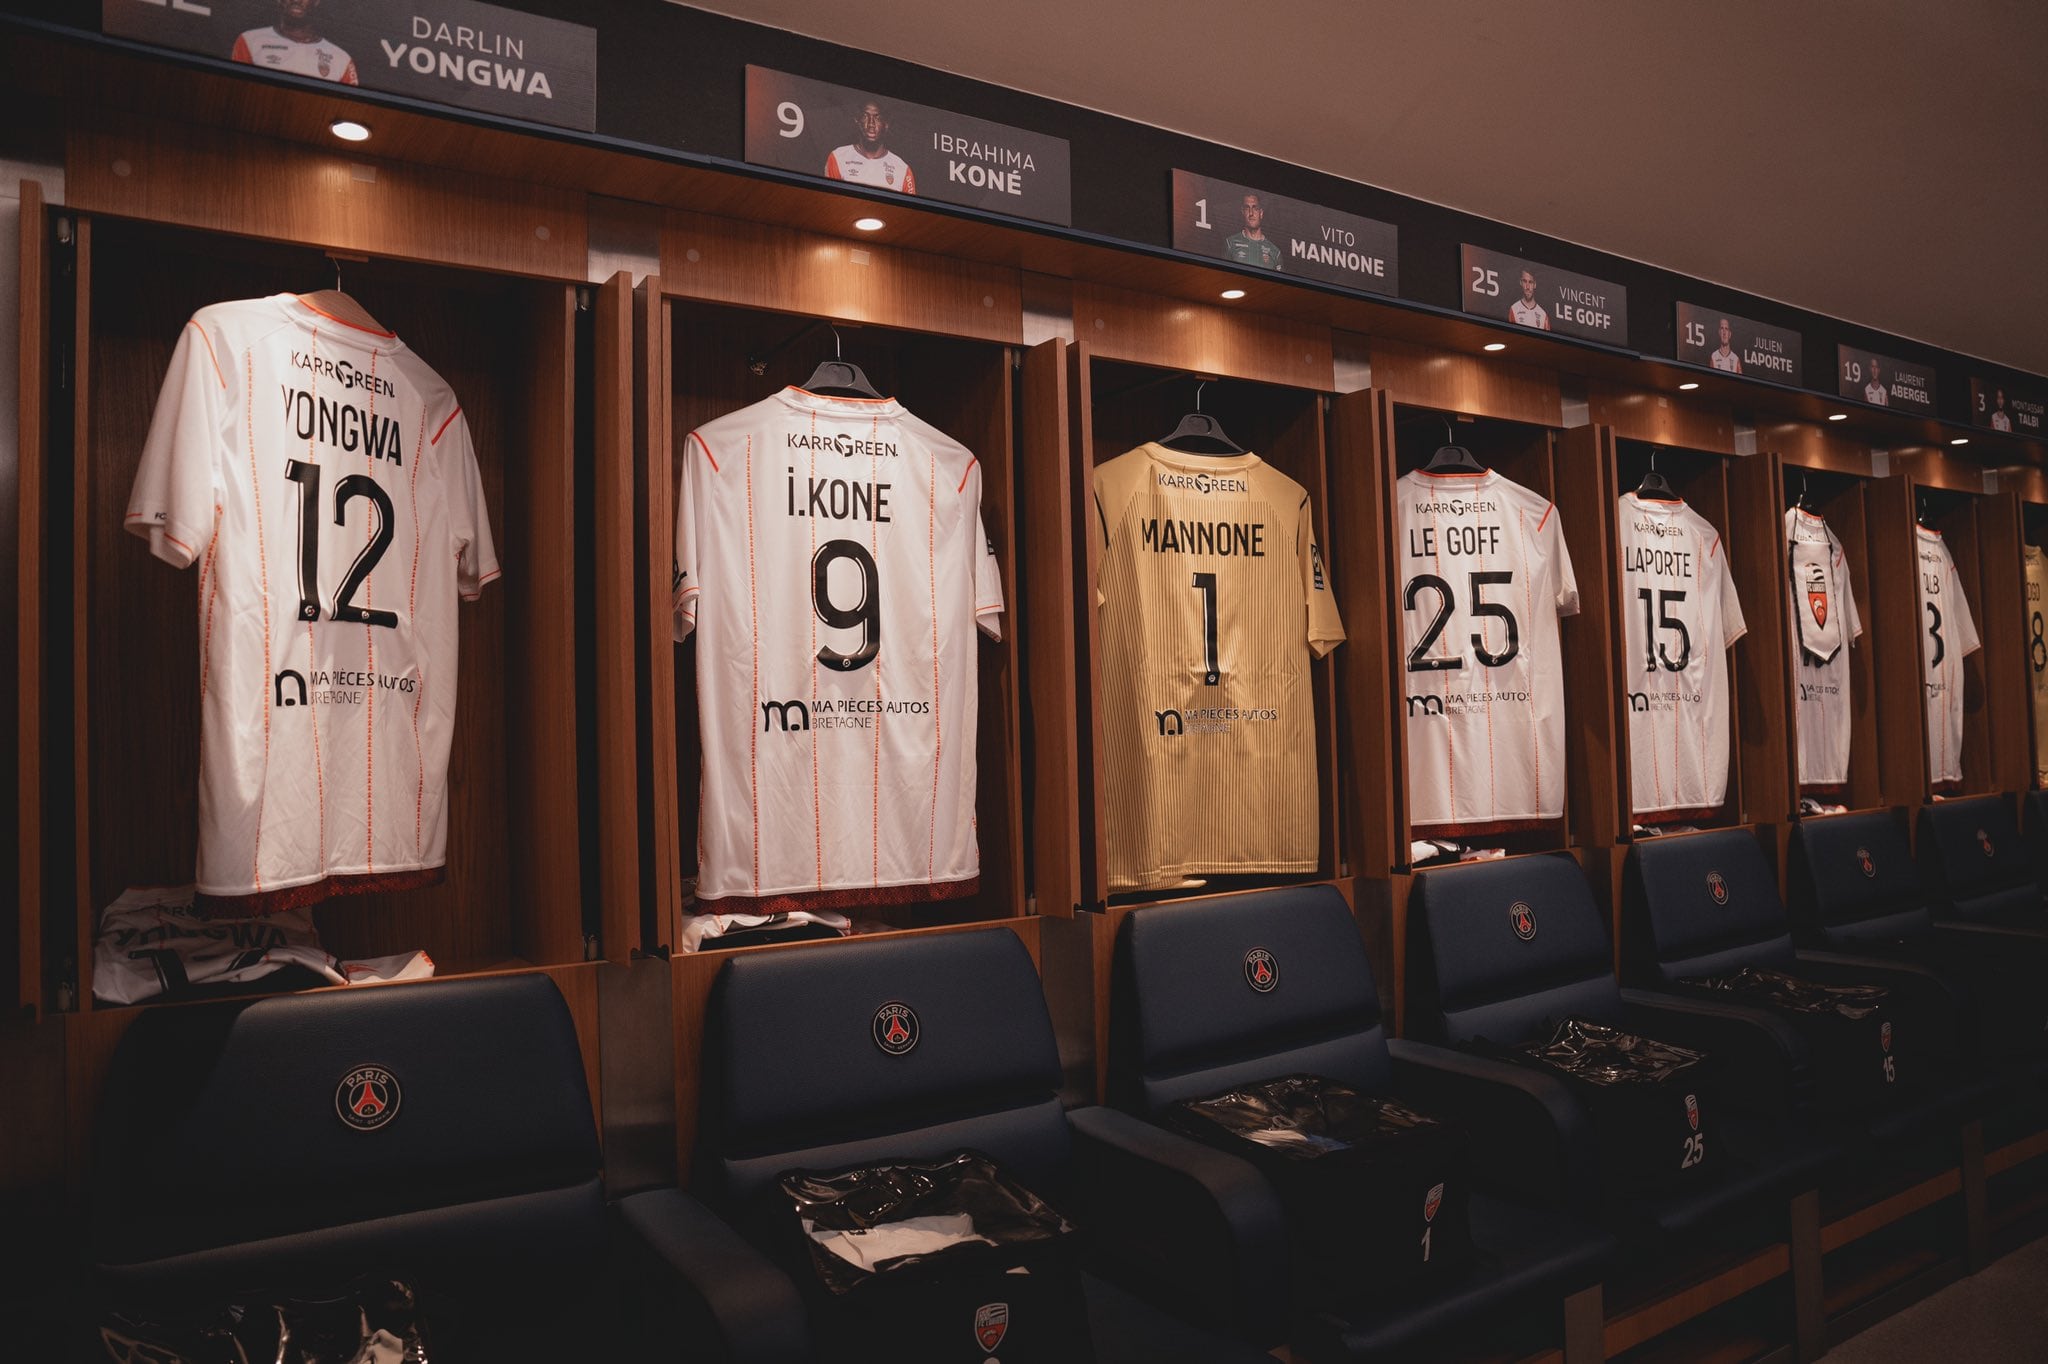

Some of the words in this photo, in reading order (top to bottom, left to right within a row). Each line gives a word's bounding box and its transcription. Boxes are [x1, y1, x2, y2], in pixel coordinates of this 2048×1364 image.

[411, 15, 525, 61] DARLIN
[380, 38, 553, 99] YONGWA
[776, 101, 805, 138] 9
[933, 132, 1036, 172] IBRAHIMA
[949, 160, 1022, 195] KONÉ
[1195, 198, 1212, 230] 1
[1321, 225, 1355, 247] VITO
[1291, 238, 1385, 278] MANNONE
[1472, 266, 1500, 297] 25
[1559, 285, 1606, 310] VINCENT
[1555, 302, 1573, 321] LE
[1575, 308, 1611, 330] GOFF
[1685, 321, 1705, 347] 15
[1754, 337, 1783, 353] JULIEN
[1744, 348, 1793, 374] LAPORTE
[1844, 360, 1861, 384] 19
[1890, 383, 1931, 405] ABERGEL
[1894, 371, 1925, 388] LAURENT
[1978, 393, 1986, 413] 3
[2011, 399, 2044, 415] MONTASSAR
[281, 384, 402, 467] YONGWA
[2018, 412, 2039, 428] TALBI
[284, 458, 398, 629] 12
[1141, 517, 1265, 557] MANNONE
[1410, 527, 1437, 558] LE
[1446, 526, 1500, 556] GOFF
[1625, 546, 1692, 578] LAPORTE
[811, 539, 880, 672] 9
[1192, 572, 1220, 686] 1
[1403, 571, 1519, 672] 25
[1637, 587, 1691, 673] 15
[1927, 602, 1944, 669] 3
[378, 674, 416, 693] AUTOS
[1445, 694, 1464, 704] MA
[812, 700, 834, 713] MA
[886, 701, 930, 714] AUTOS
[812, 717, 872, 729] BRETAGNE
[880, 1006, 909, 1020] PARIS
[346, 1070, 389, 1088] PARIS
[1883, 1055, 1896, 1083] 15
[1681, 1132, 1704, 1169] 25
[1420, 1226, 1433, 1262] 1
